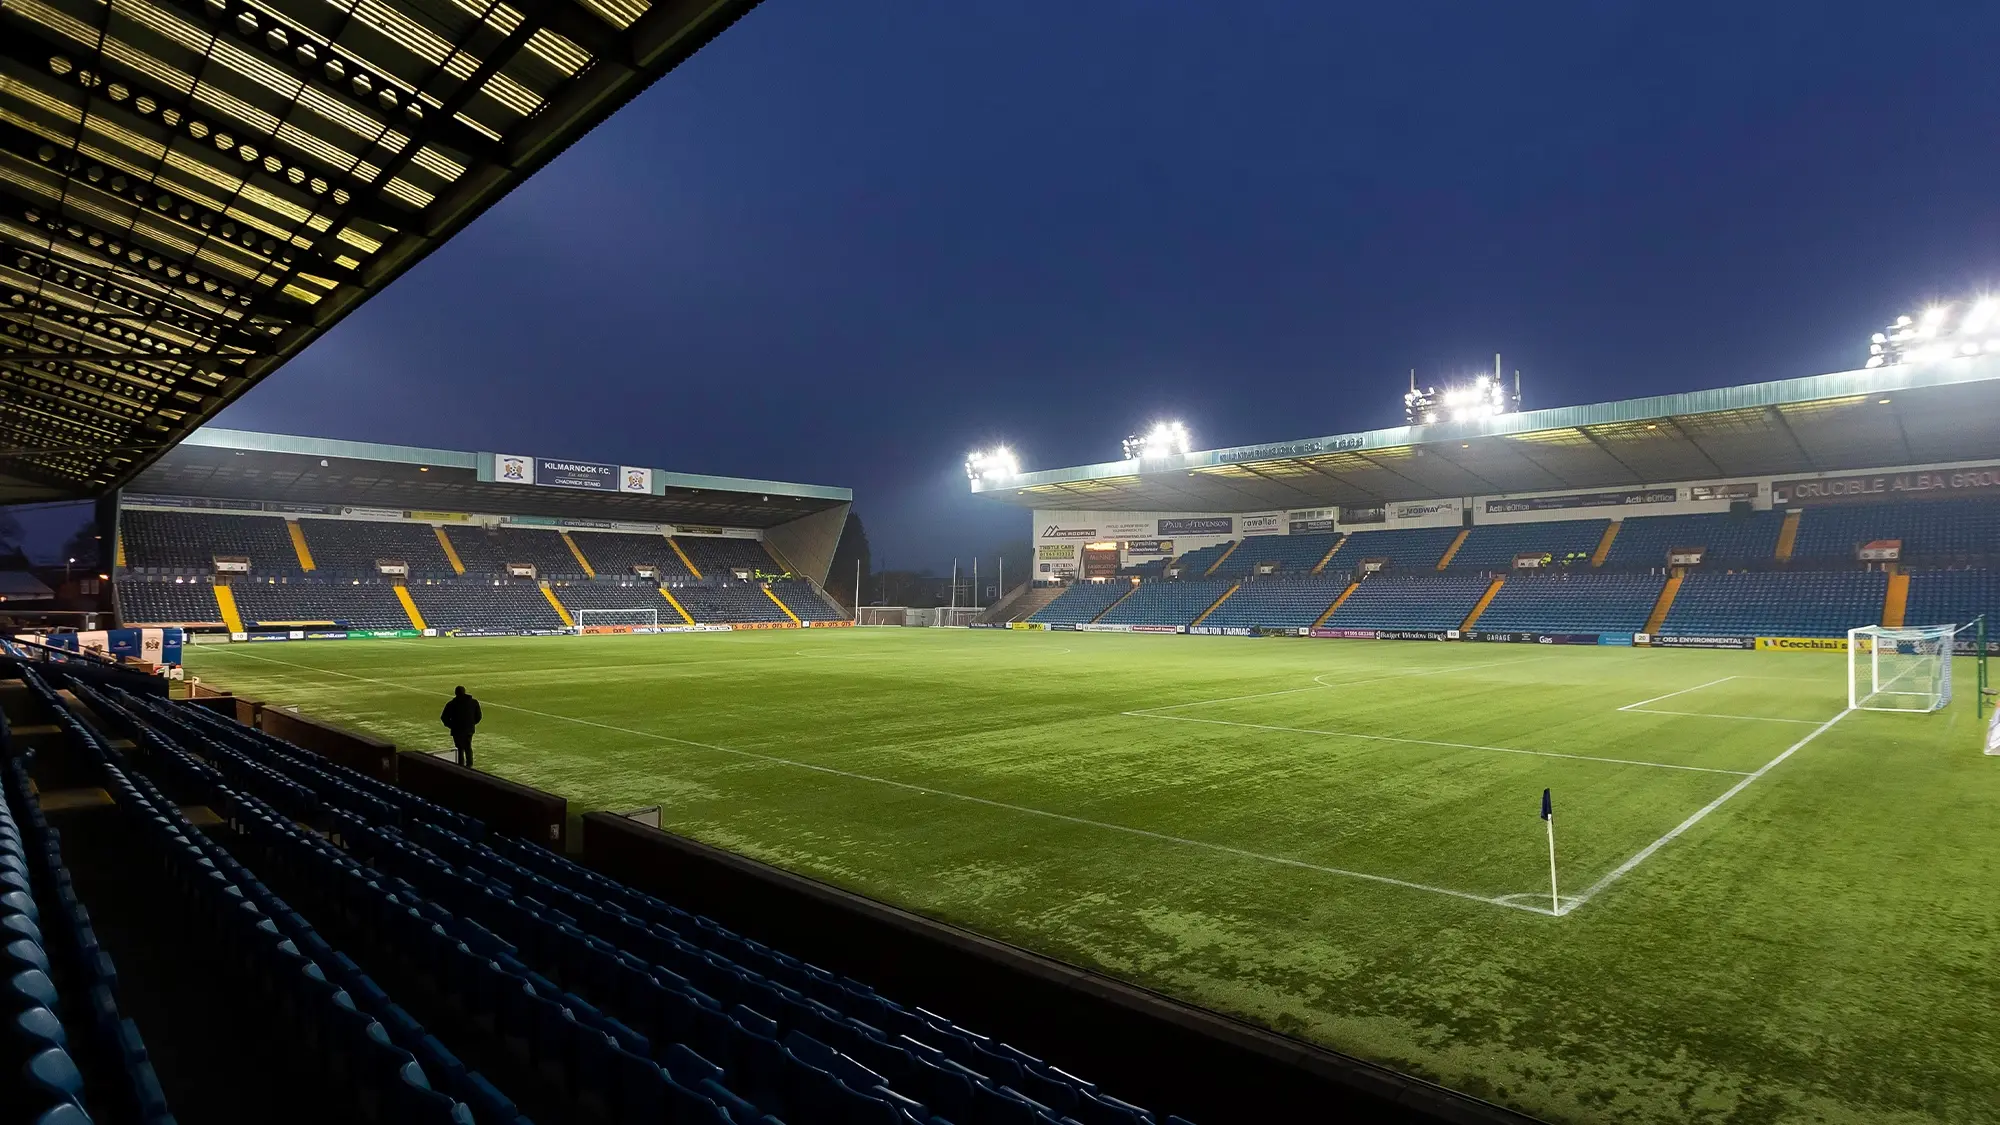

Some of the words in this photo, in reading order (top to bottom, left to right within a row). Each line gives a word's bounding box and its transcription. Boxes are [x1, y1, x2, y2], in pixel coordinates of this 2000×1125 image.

[544, 462, 597, 474] KILMARNOCK
[598, 467, 611, 475] F.C.
[554, 478, 583, 486] CHADWICK
[1796, 478, 1885, 498] CRUCIBLE
[1890, 475, 1946, 492] ALBA
[1405, 505, 1439, 515] MODWAY
[1163, 520, 1182, 530] PAUL
[1185, 520, 1228, 529] STEVENSON
[1243, 517, 1277, 527] rowallan
[1189, 626, 1222, 635] HAMILTON
[1223, 627, 1251, 636] TARMAC
[1380, 632, 1400, 640] Budget
[1427, 632, 1447, 640] Blinds
[1486, 633, 1511, 641] GARAGE
[1539, 635, 1553, 643] Gas
[1662, 635, 1678, 643] ODS
[1679, 636, 1743, 644] ENVIRONMENTAL
[1780, 639, 1838, 649] Cecchini
